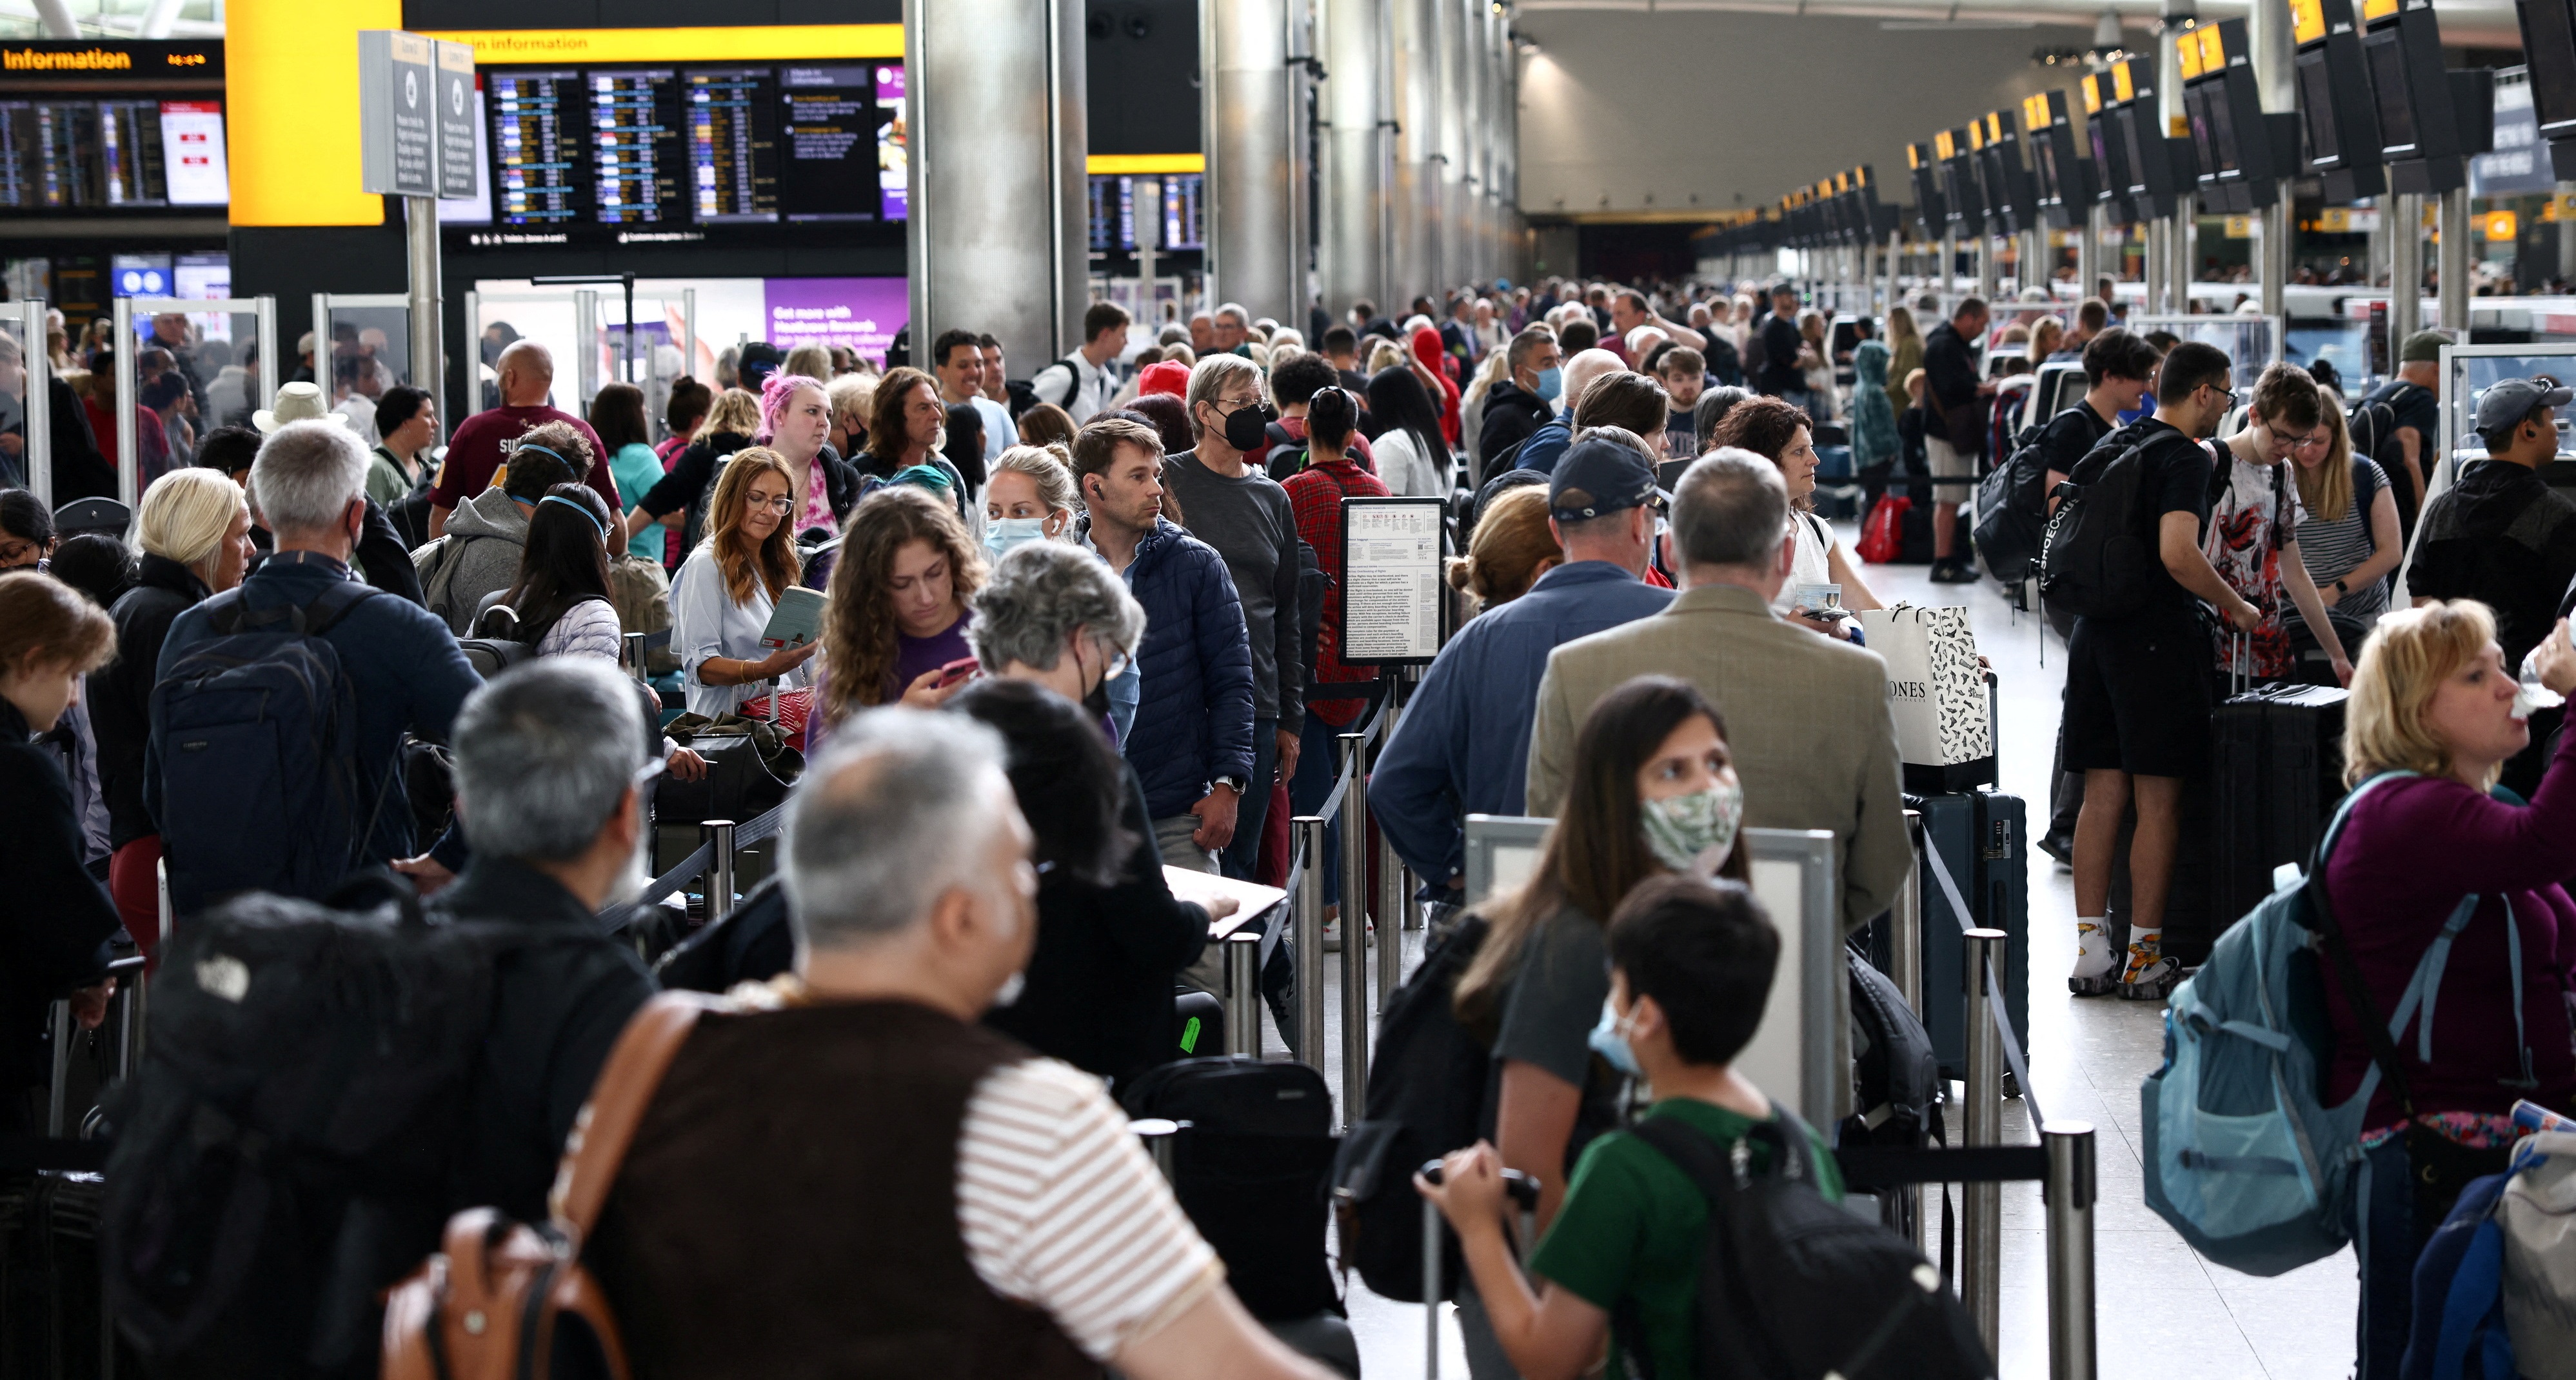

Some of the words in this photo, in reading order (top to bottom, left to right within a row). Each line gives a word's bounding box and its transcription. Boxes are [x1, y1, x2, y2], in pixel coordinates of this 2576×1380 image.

[491, 34, 588, 50] information
[3, 48, 132, 70] Information
[773, 306, 794, 319] Get
[794, 308, 824, 319] more
[824, 305, 851, 319] with
[828, 319, 877, 333] Rewards
[500, 439, 518, 453] SU
[1890, 681, 1926, 698] ONES
